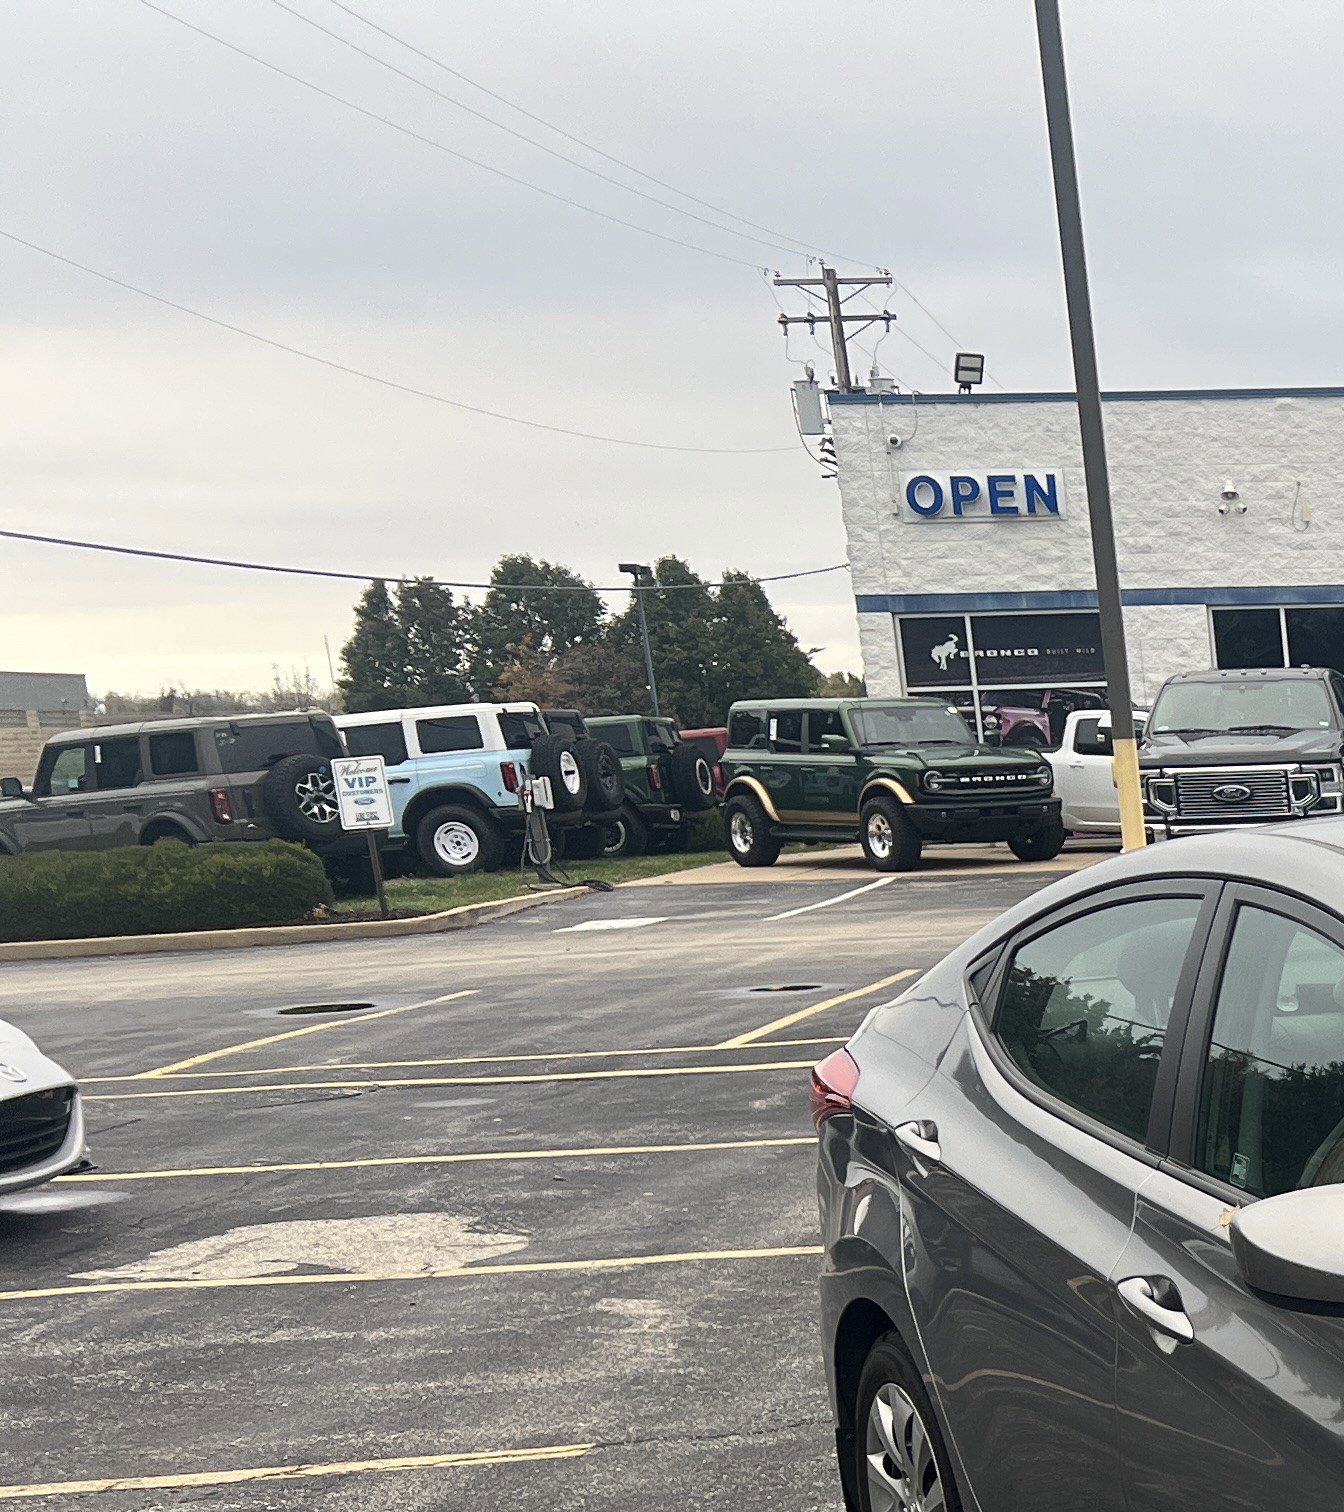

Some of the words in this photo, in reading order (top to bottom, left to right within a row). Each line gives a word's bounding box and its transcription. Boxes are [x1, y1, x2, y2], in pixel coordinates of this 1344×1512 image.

[906, 473, 1060, 516] OPEN
[960, 648, 1039, 658] BRONCO
[343, 776, 377, 789] VIP
